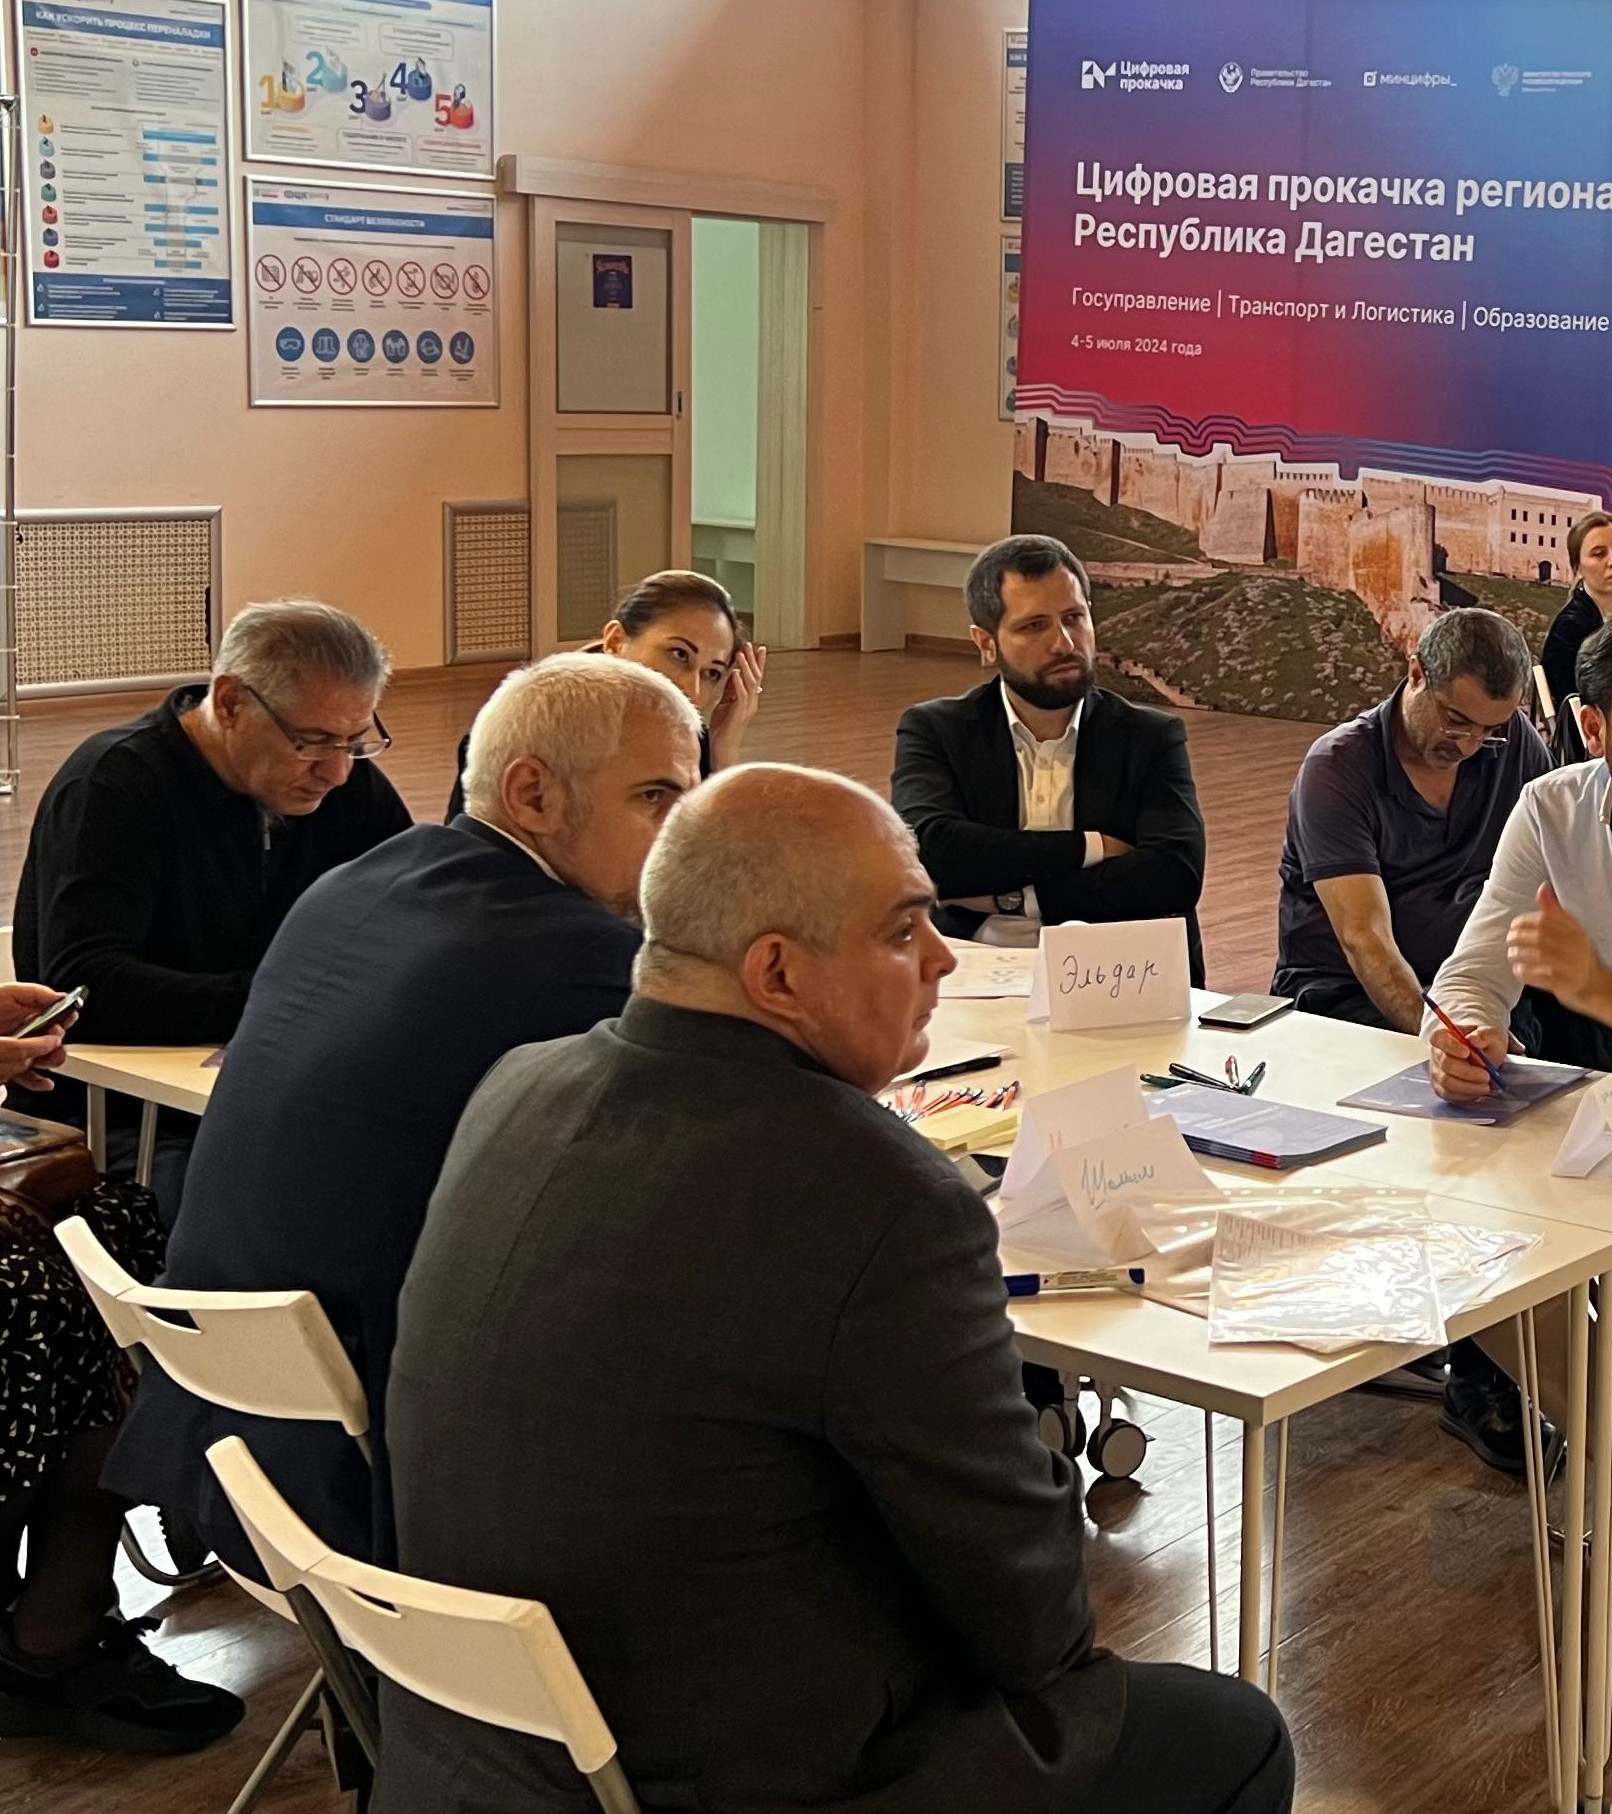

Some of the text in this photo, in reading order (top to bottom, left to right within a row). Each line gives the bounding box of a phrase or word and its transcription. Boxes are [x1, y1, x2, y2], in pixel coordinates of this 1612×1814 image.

[56, 13, 104, 27] УСКОРИТЬ
[104, 18, 147, 32] ПРОЦЕСС
[147, 23, 212, 39] ПЕРЕНАЛАДКИ
[306, 50, 325, 87] 2
[389, 62, 408, 95] 4
[1119, 78, 1184, 91] прокачка
[1120, 60, 1190, 78] Цифровая
[258, 74, 279, 110] 1
[349, 79, 368, 114] 3
[434, 93, 452, 127] 5
[1075, 161, 1259, 206] Цифровая
[1268, 174, 1446, 210] прокачка
[324, 213, 426, 228] СТАНДАРТ БЕЗОПАСНОСТИ
[1074, 213, 1475, 263] Республика Дагестан
[1072, 287, 1610, 332] Госуправление Транспорт и Логистика Образование
[1070, 335, 1203, 357] 4-5 июля 2024 года
[1059, 954, 1159, 999] Эльдар
